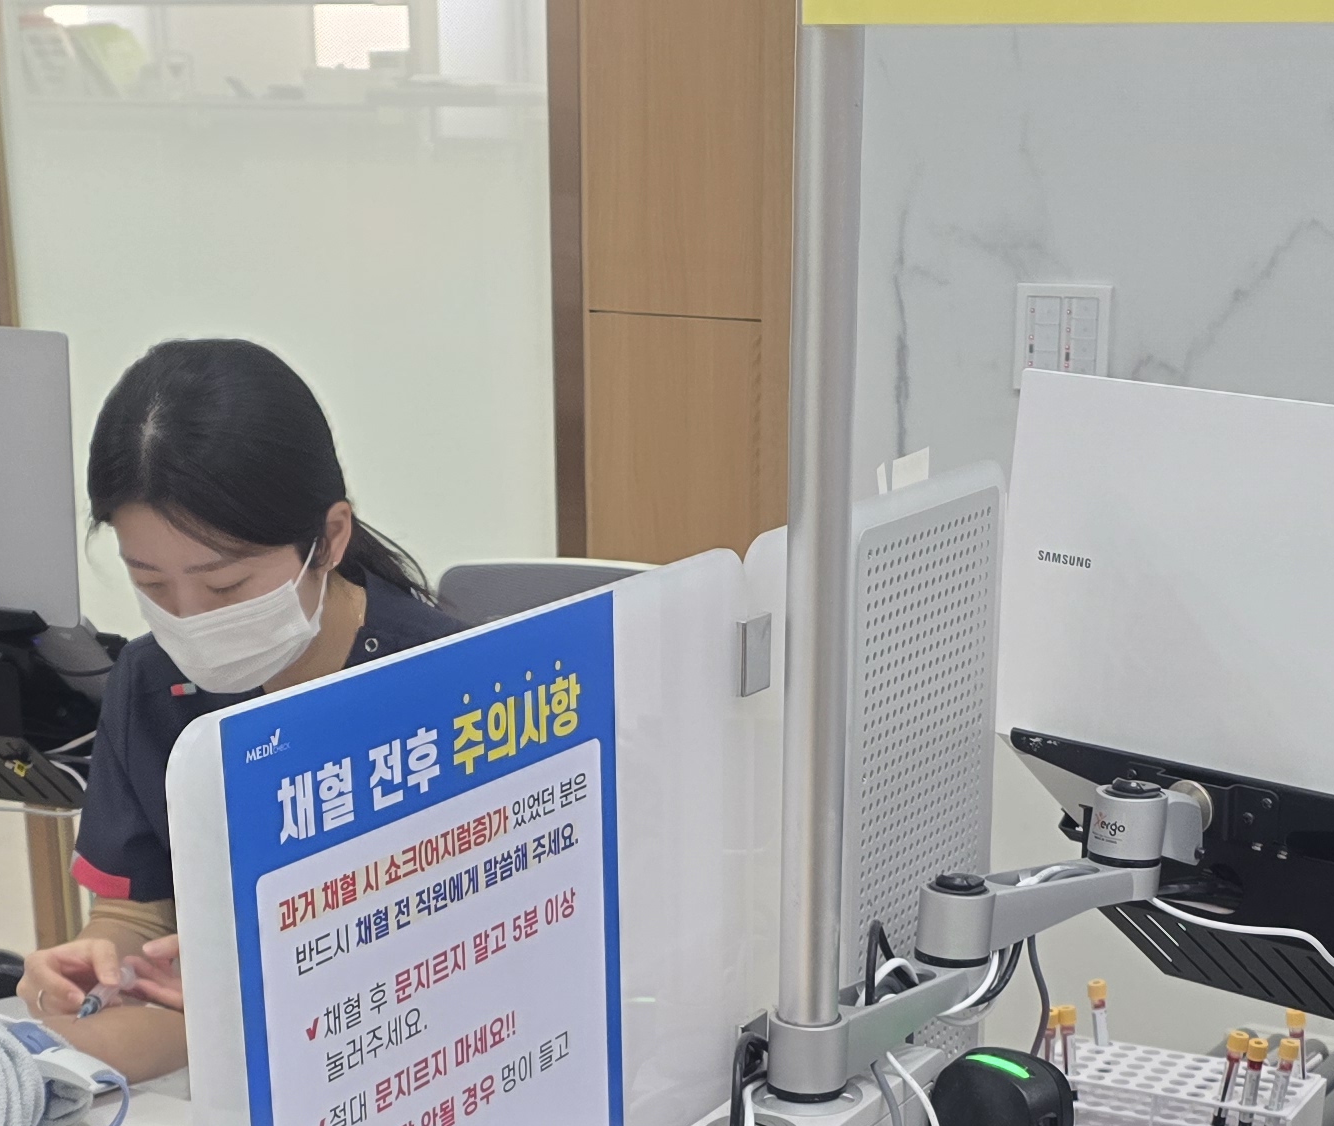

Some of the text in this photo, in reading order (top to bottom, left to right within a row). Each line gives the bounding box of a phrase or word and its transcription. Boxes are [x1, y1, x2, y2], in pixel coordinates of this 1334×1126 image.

[1037, 550, 1092, 569] SAMSUNG
[246, 742, 273, 764] MEDI
[277, 672, 581, 845] 채혈 전후 주의사항
[279, 772, 587, 932] 과거 채혈 시 쇼크(어지럼증)가 있었던 분은
[295, 822, 579, 976] 반드시 채혈 전 직원에게 말씀해 주세요.
[323, 886, 576, 1039] 채혈 후 문지르지 말고 5분 이상
[324, 1007, 428, 1083] 눌러주세요.
[374, 1047, 447, 1114] 문지르지
[454, 1010, 516, 1068] 마세요!!
[461, 1074, 496, 1117] 경우
[501, 1051, 532, 1093] 멍이
[538, 1030, 570, 1072] 들고
